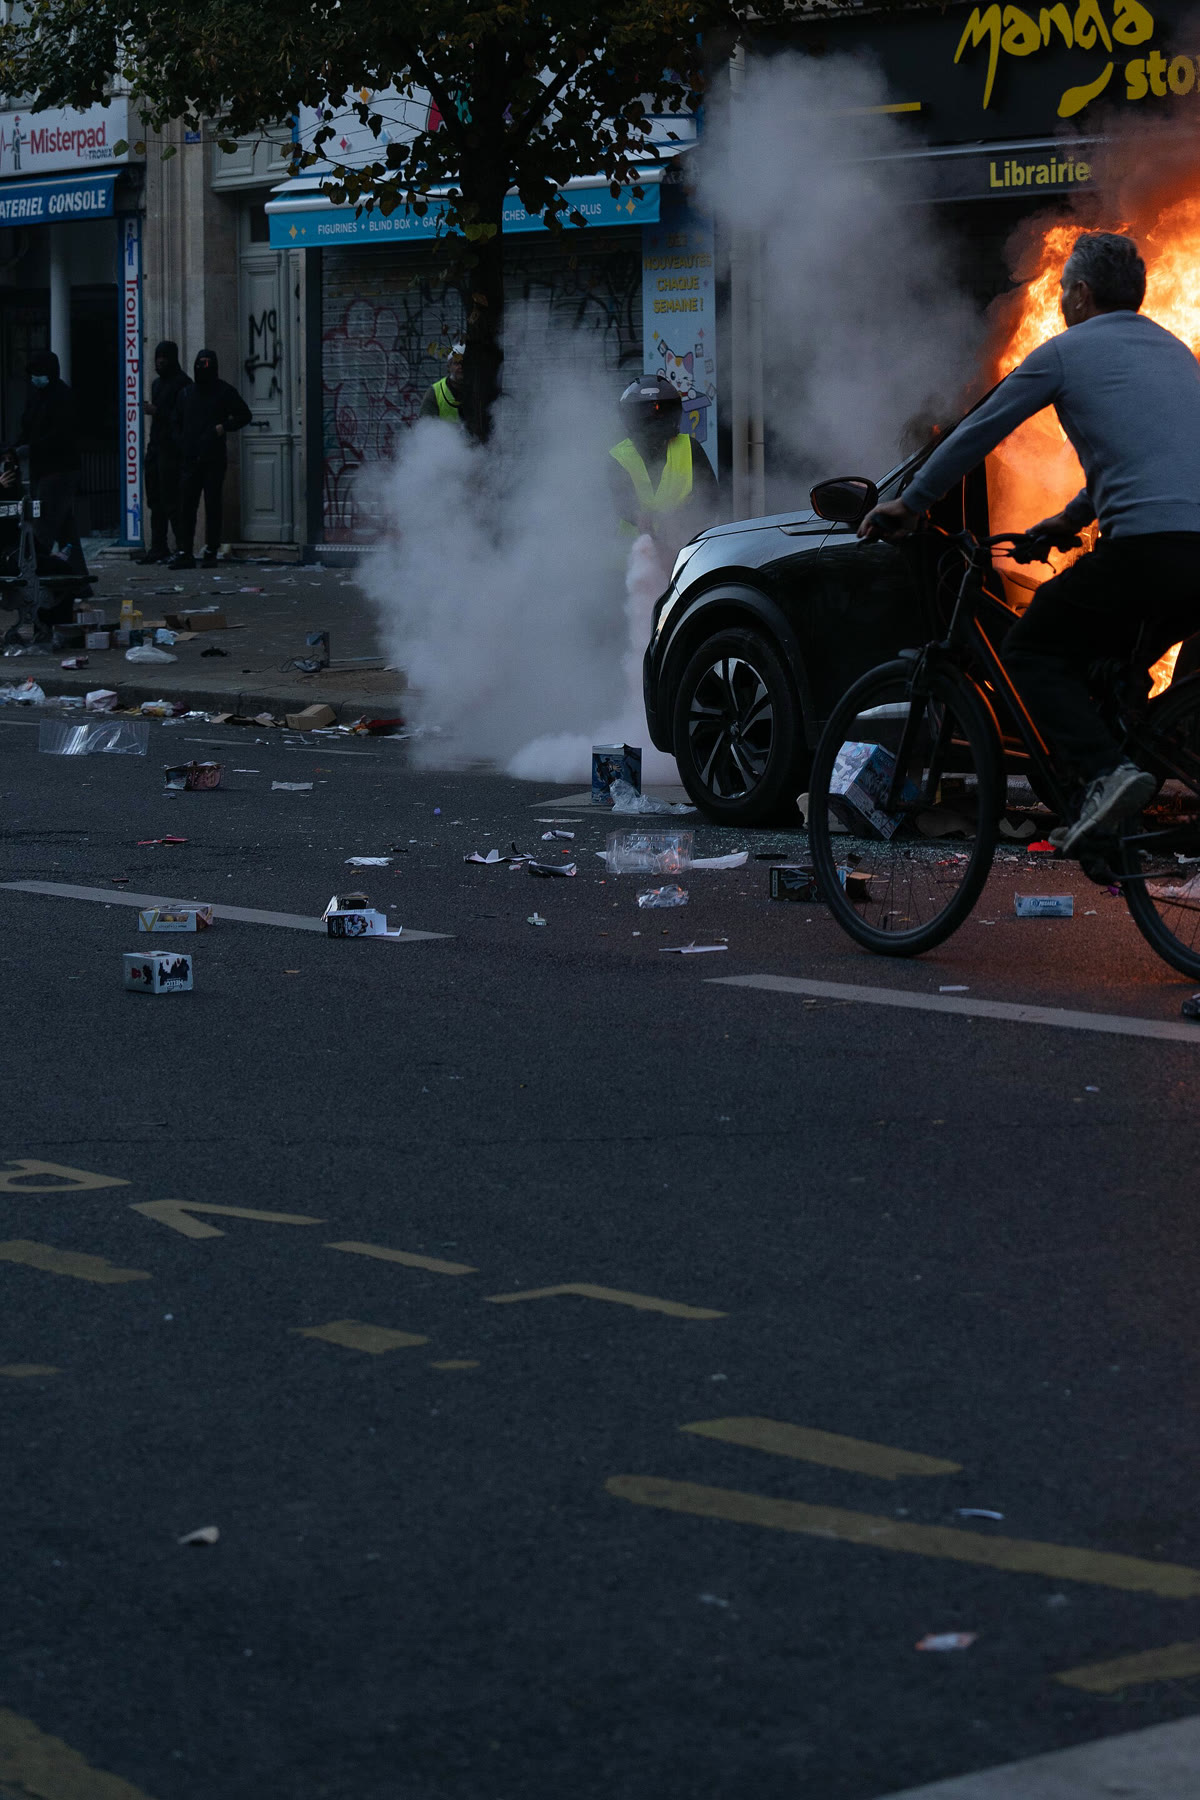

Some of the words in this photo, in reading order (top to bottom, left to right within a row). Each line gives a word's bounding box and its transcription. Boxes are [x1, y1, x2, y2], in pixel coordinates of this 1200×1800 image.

[31, 121, 105, 157] Misterpad
[89, 147, 113, 160] TRONIX
[989, 157, 1091, 188] Librairie
[48, 189, 106, 214] CONSOLE
[318, 221, 358, 235] FIGURINES
[369, 220, 393, 232] BLIND
[394, 218, 411, 230] BOX
[580, 203, 602, 215] PLUS
[657, 276, 700, 291] CHAQUE
[654, 297, 698, 313] SEMAINE
[126, 274, 140, 484] Tronix-Paris.com
